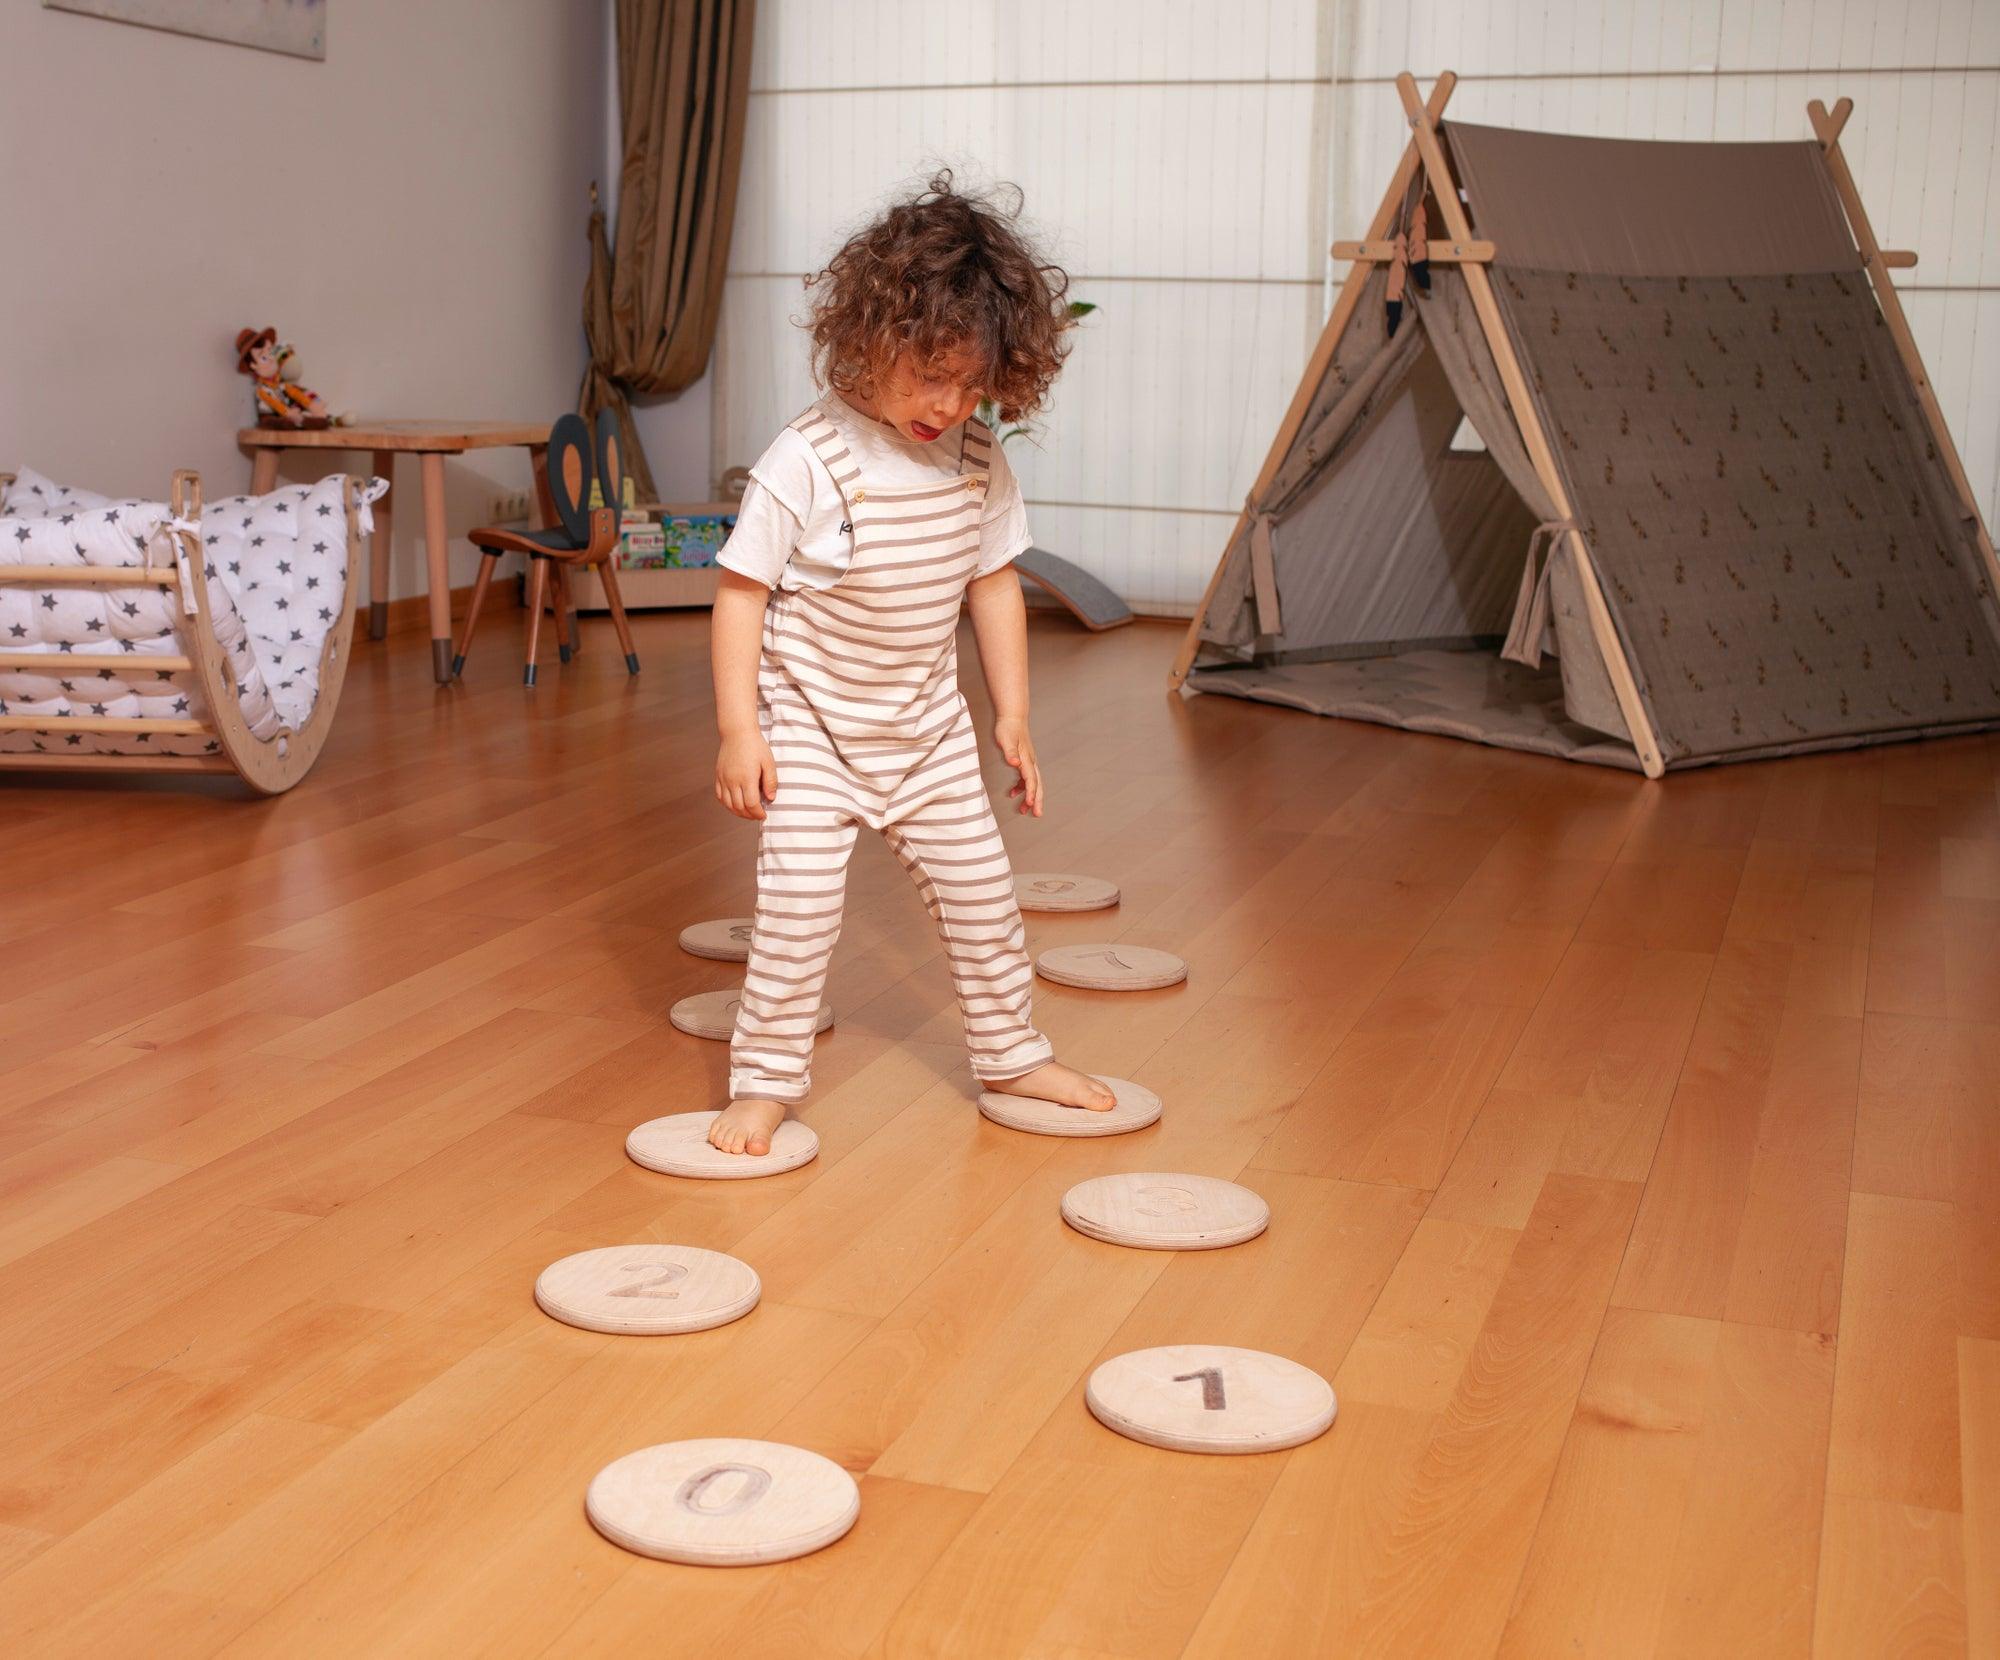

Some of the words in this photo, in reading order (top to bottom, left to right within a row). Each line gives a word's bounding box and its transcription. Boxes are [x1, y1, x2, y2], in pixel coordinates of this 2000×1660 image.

[1072, 950, 1133, 970] 7
[1134, 1186, 1199, 1217] 3
[605, 1261, 688, 1299] 2
[1173, 1367, 1226, 1410] 1
[673, 1462, 772, 1517] 0
